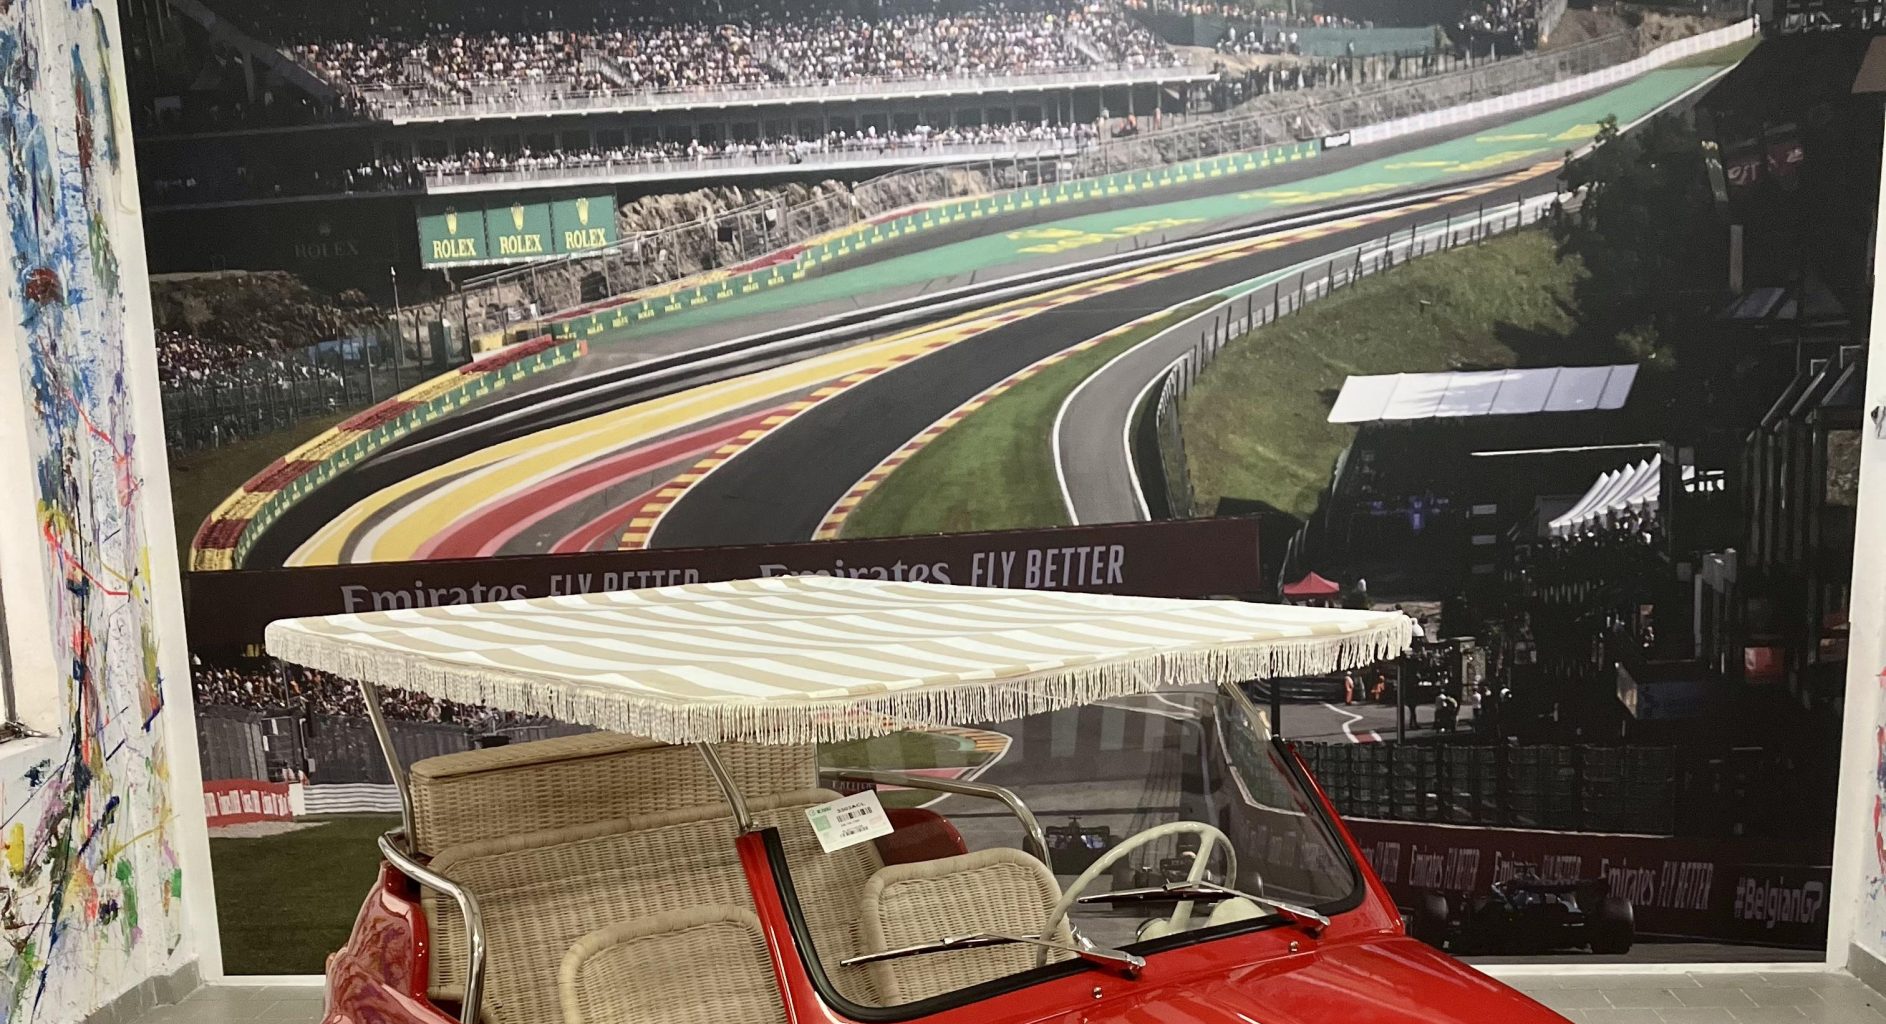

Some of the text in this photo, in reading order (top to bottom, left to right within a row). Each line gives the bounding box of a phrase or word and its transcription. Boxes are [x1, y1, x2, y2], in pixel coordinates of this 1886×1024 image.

[433, 238, 477, 259] ROLEX
[500, 234, 543, 254] ROLEX
[565, 228, 607, 249] ROLEX
[760, 544, 1125, 588] irates FLY BETTER
